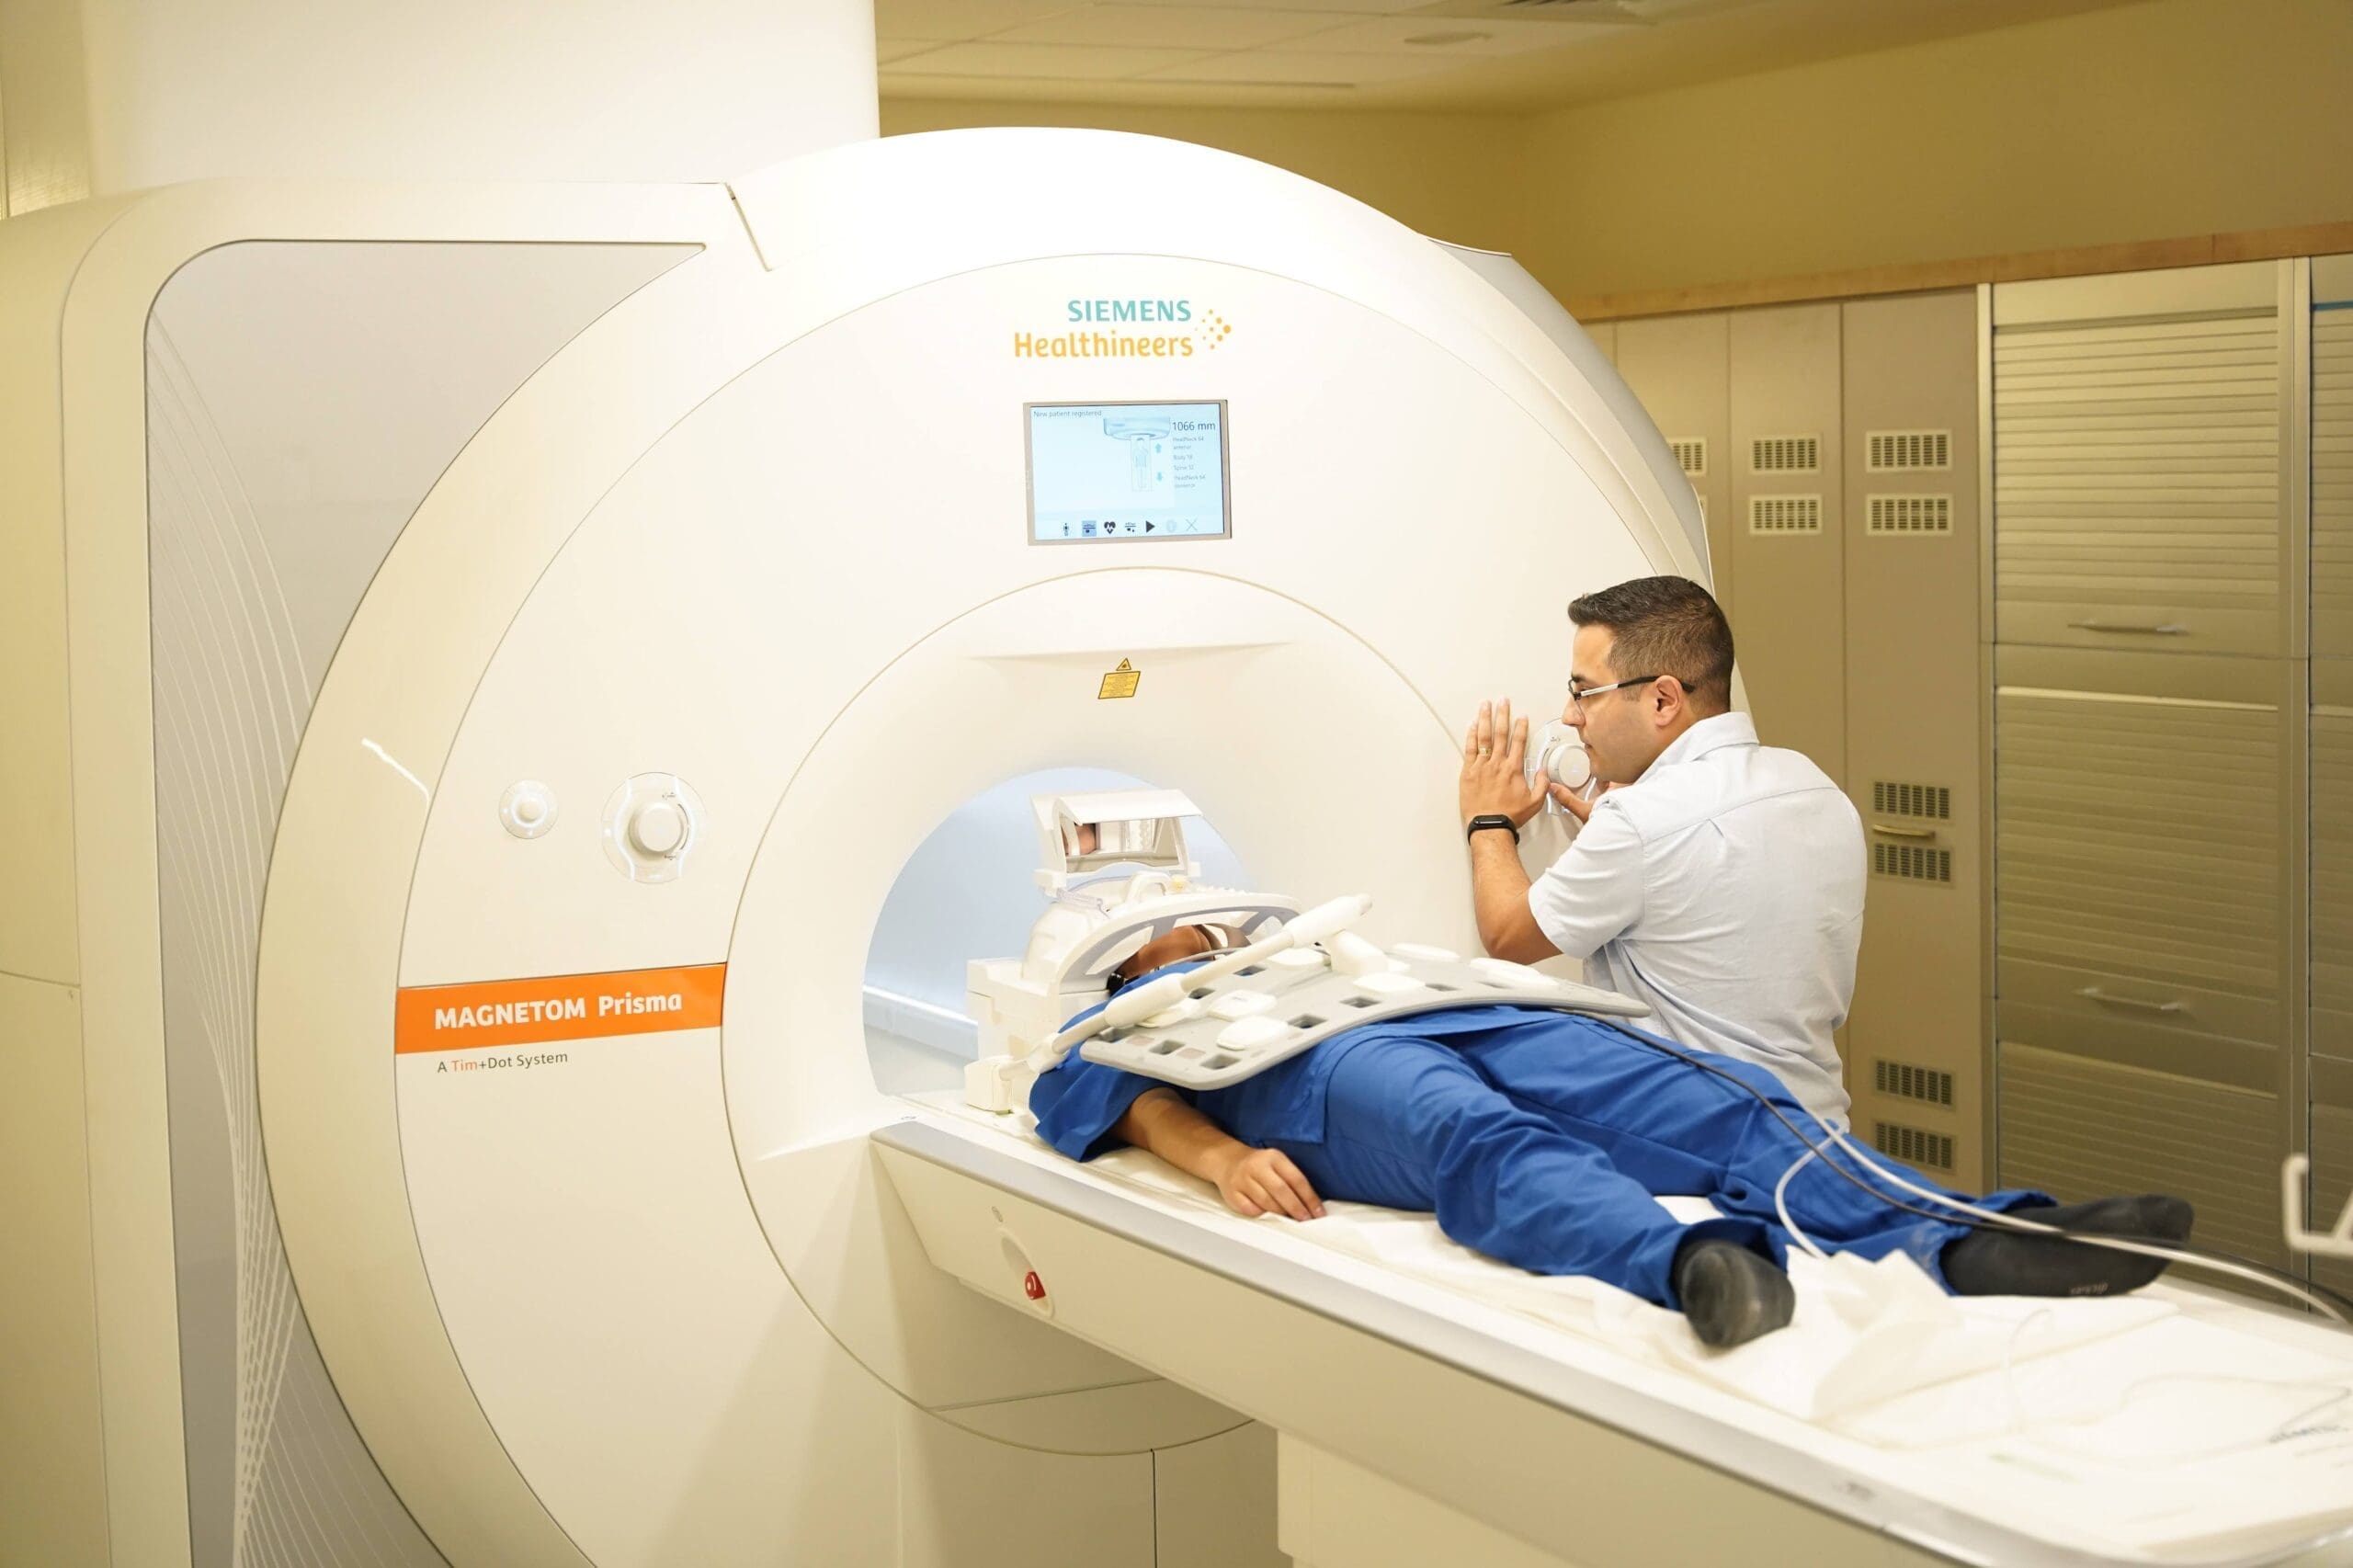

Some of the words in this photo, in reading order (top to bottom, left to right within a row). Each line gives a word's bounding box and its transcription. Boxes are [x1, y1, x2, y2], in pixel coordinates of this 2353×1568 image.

[1067, 300, 1191, 322] SIEMENS
[1014, 329, 1193, 358] Healthineers
[1072, 410, 1102, 418] registered
[1172, 421, 1195, 431] 1066
[434, 997, 586, 1029] MAGNETOM
[598, 992, 682, 1017] Prisma
[438, 1061, 448, 1074] A
[451, 1056, 512, 1073] Tim+Dot
[517, 1051, 568, 1068] System
